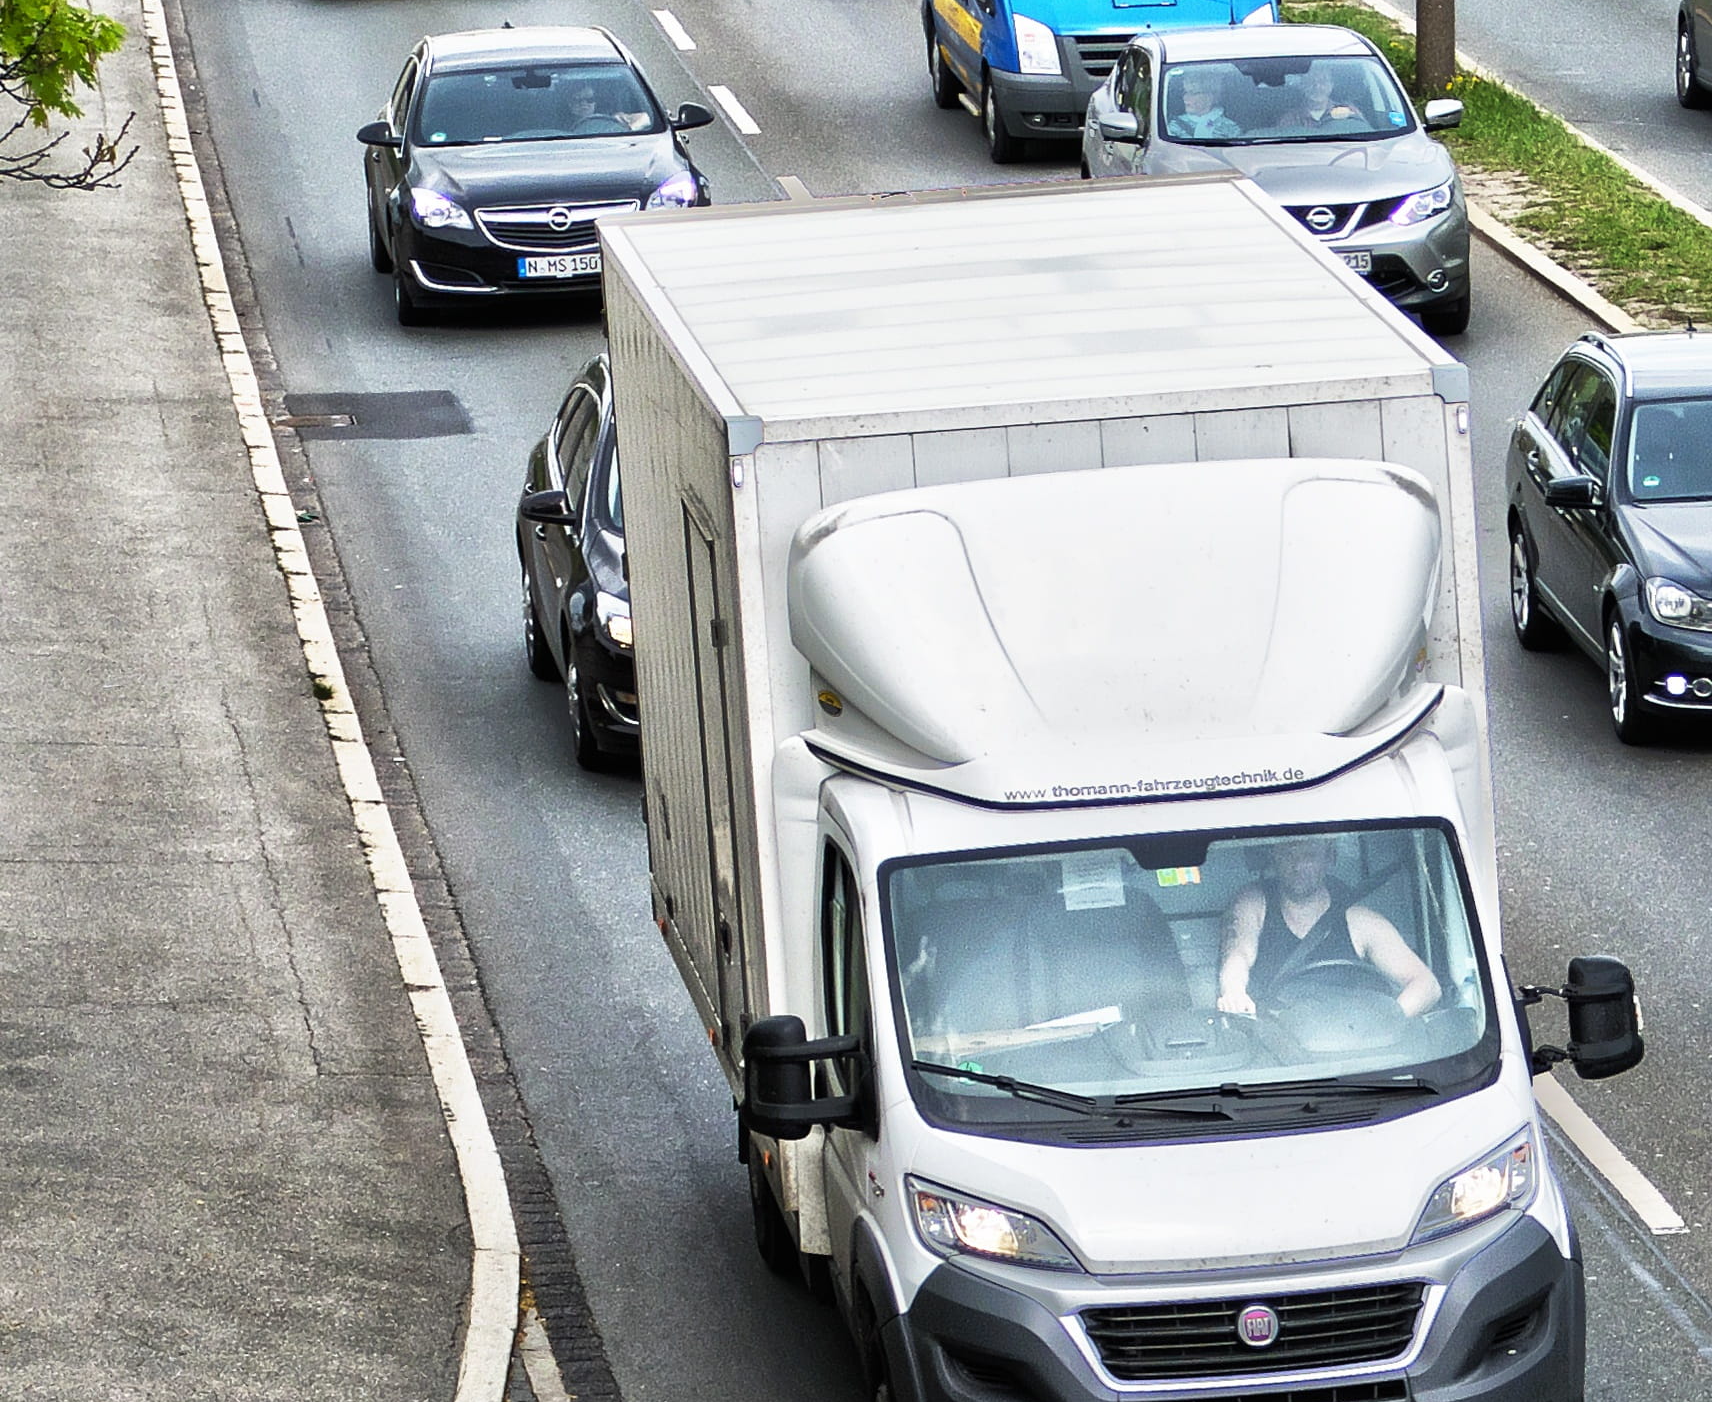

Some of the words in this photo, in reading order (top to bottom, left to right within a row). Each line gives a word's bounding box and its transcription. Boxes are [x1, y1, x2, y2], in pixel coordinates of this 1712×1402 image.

[528, 260, 538, 273] N
[547, 258, 567, 272] MS
[1246, 1317, 1271, 1337] FIAT
